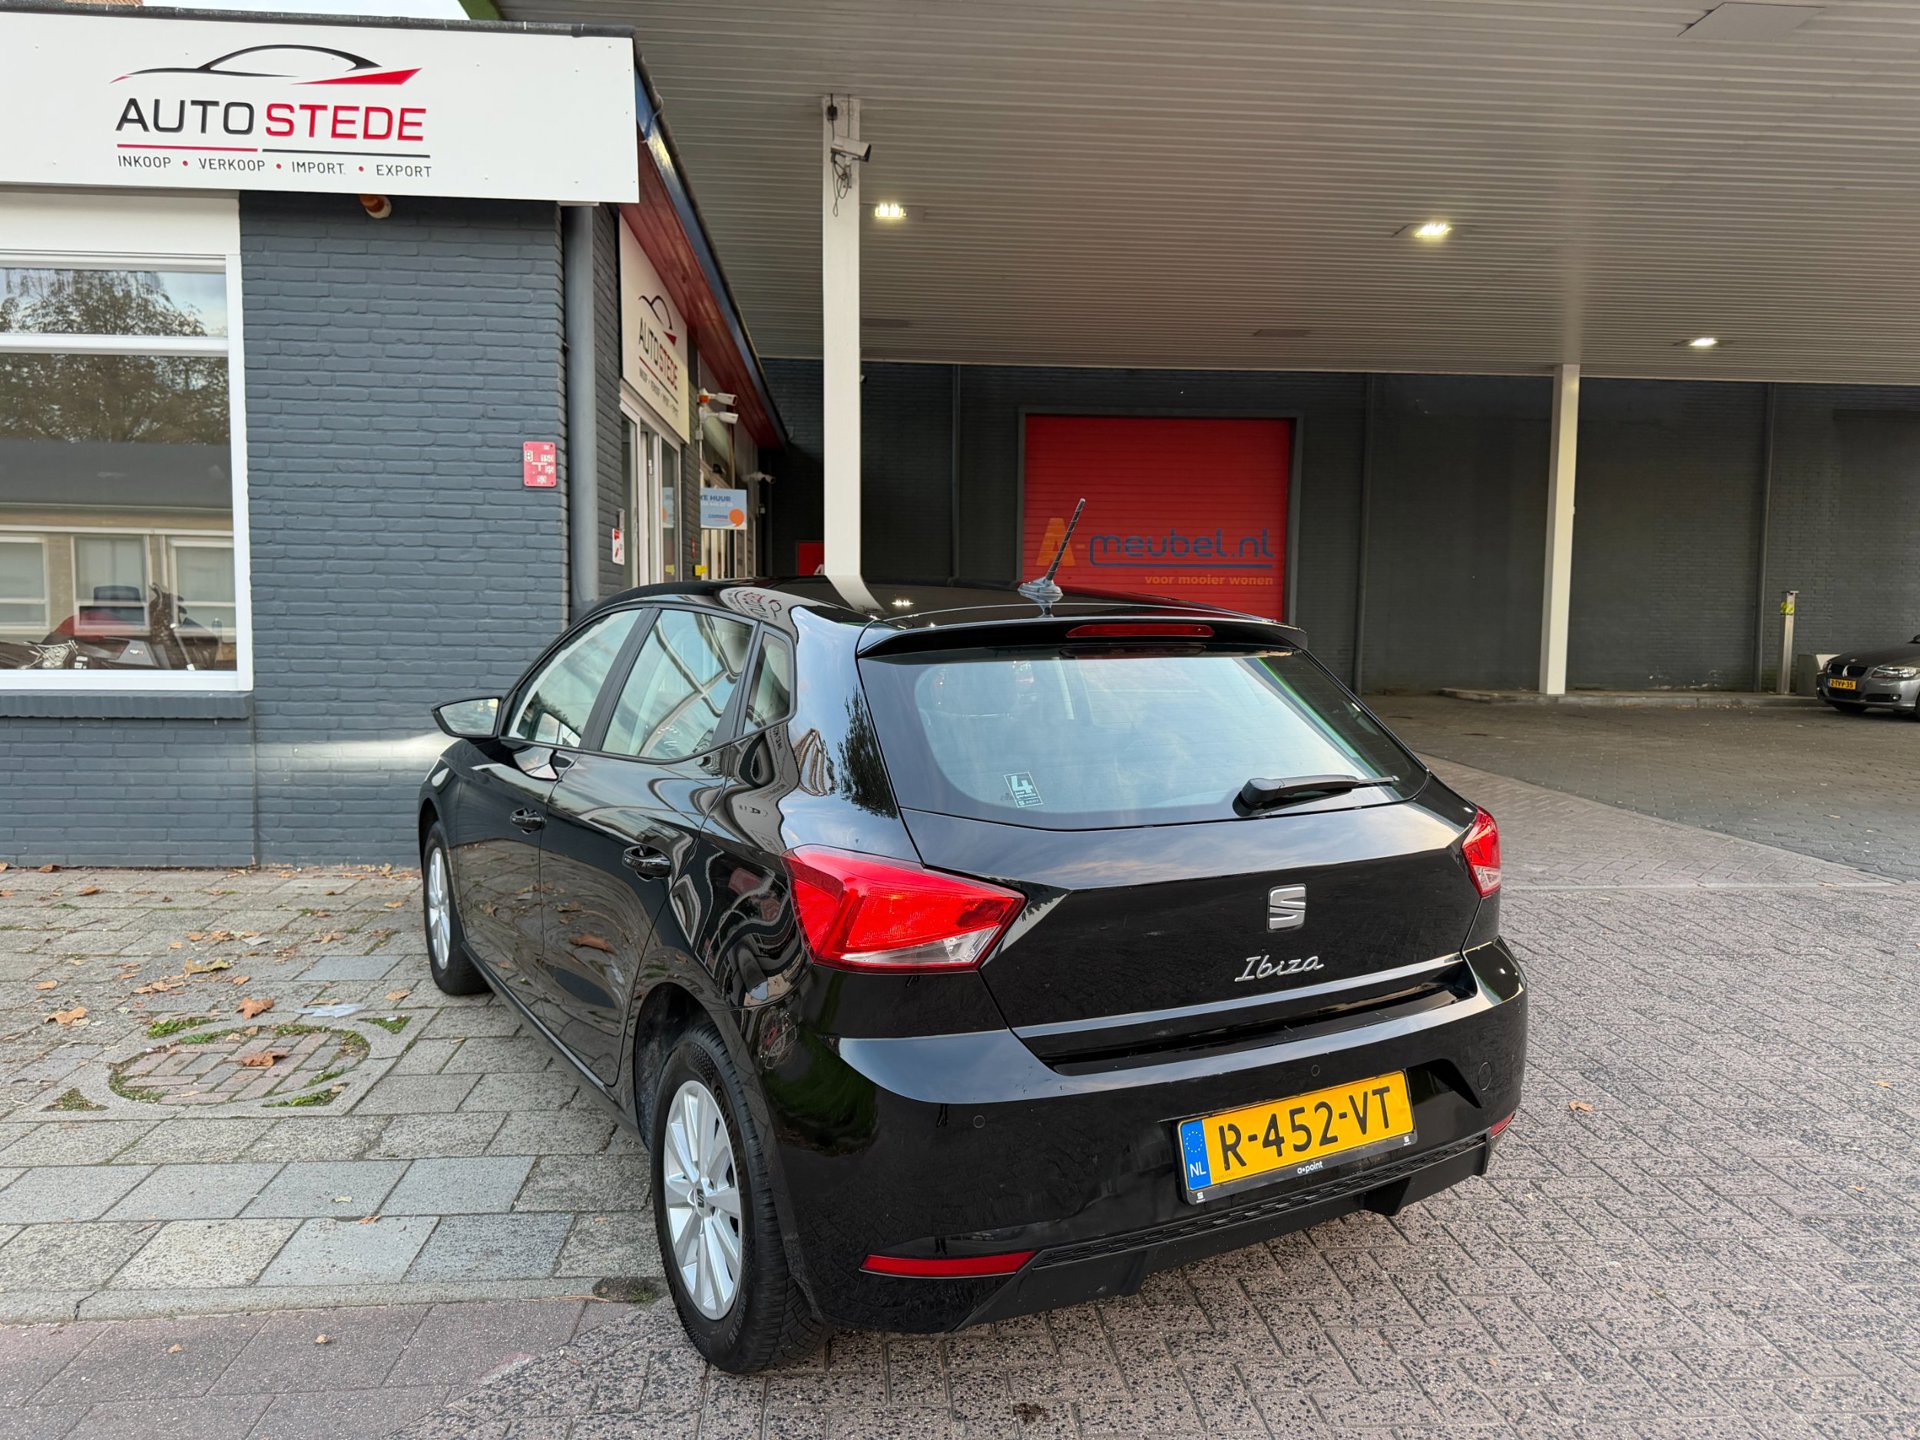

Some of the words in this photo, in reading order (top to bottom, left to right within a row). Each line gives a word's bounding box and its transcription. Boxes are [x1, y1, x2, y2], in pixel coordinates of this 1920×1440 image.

[117, 155, 172, 168] INKOOP
[198, 157, 266, 172] VERKOOP
[291, 160, 345, 175] IMPORT
[376, 164, 432, 178] EXPORT
[1145, 576, 1176, 585] voor
[1178, 574, 1225, 586] mooier
[1229, 576, 1274, 586] wonen
[1234, 954, 1325, 982] Ibiza
[1218, 1085, 1391, 1171] R-452-VT
[1189, 1161, 1208, 1179] NL
